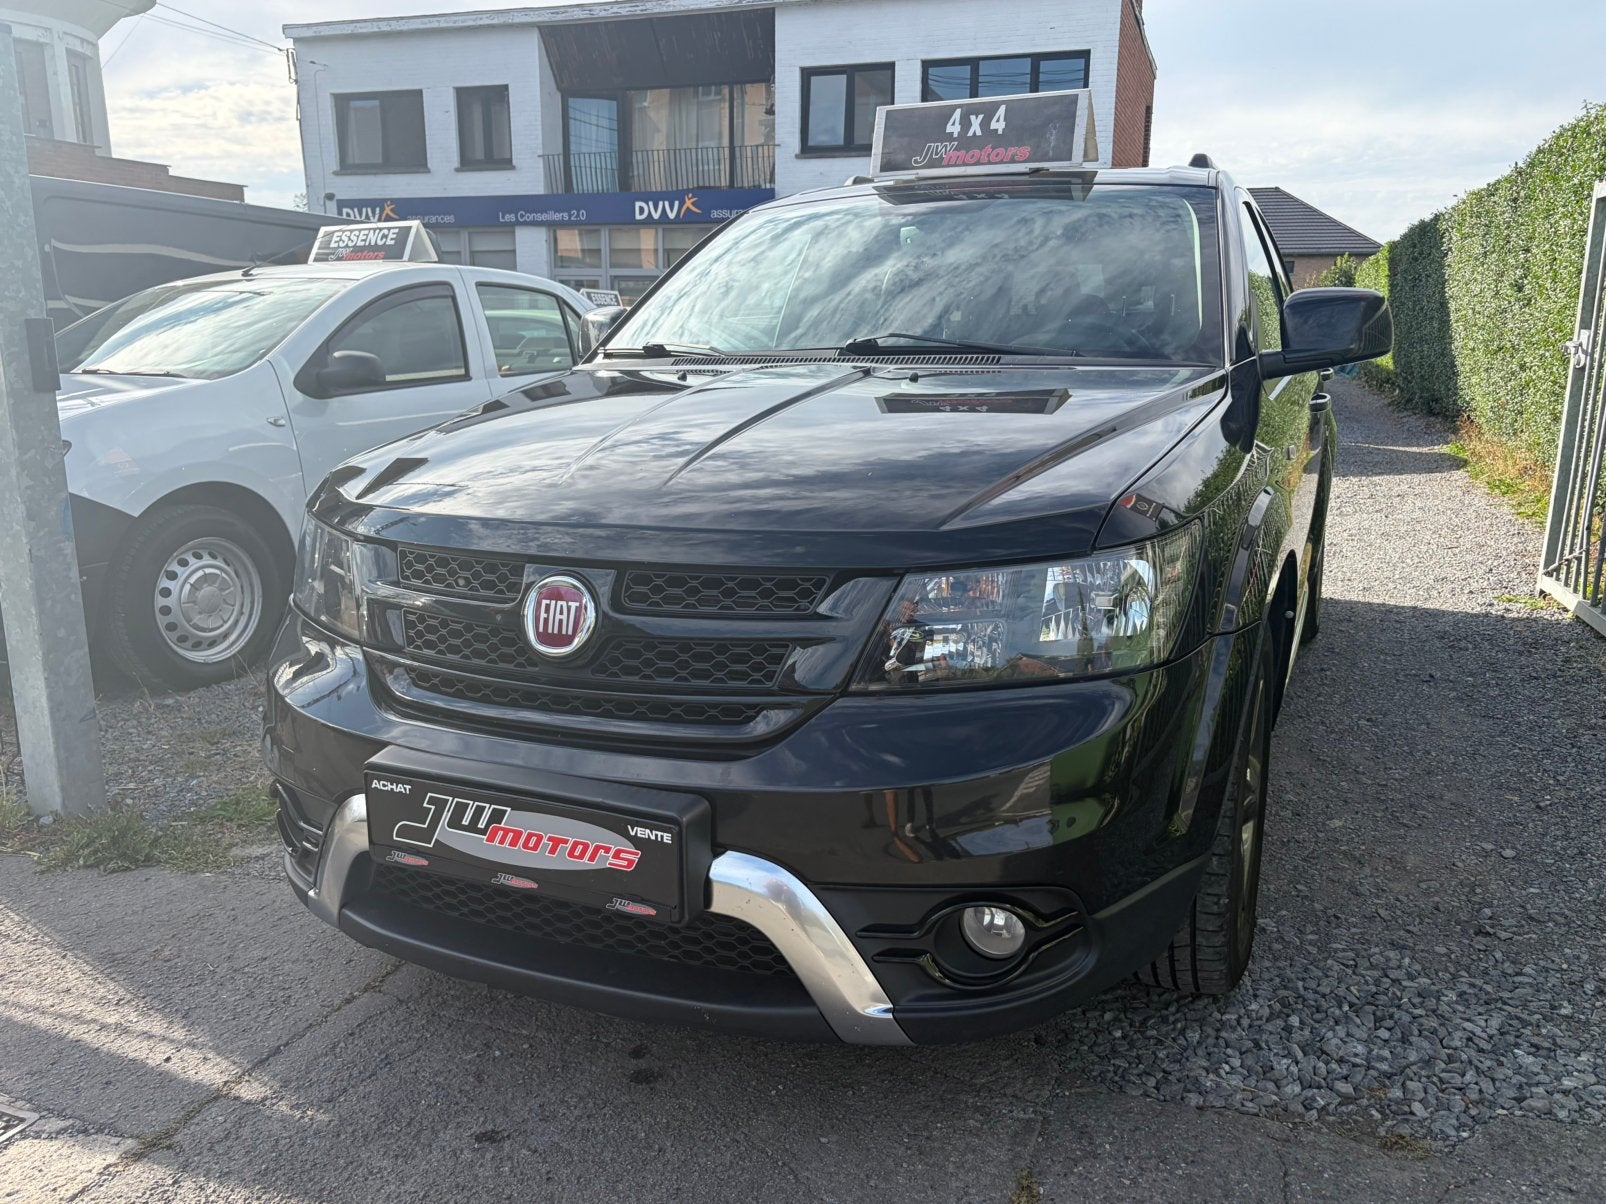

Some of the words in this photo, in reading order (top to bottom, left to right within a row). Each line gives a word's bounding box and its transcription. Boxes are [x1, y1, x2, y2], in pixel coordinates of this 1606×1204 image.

[946, 108, 961, 137] 4
[990, 104, 1006, 135] 4
[912, 142, 957, 167] JW
[942, 144, 1031, 166] motors
[499, 211, 516, 222] Les
[517, 209, 569, 222] Conseillers
[570, 209, 587, 221] 2.0
[635, 201, 679, 220] DVV
[330, 228, 399, 248] ESSENCE
[539, 599, 579, 636] FIAT
[371, 779, 412, 795] ACHAT
[393, 793, 511, 847] JW
[627, 824, 673, 844] VENTE
